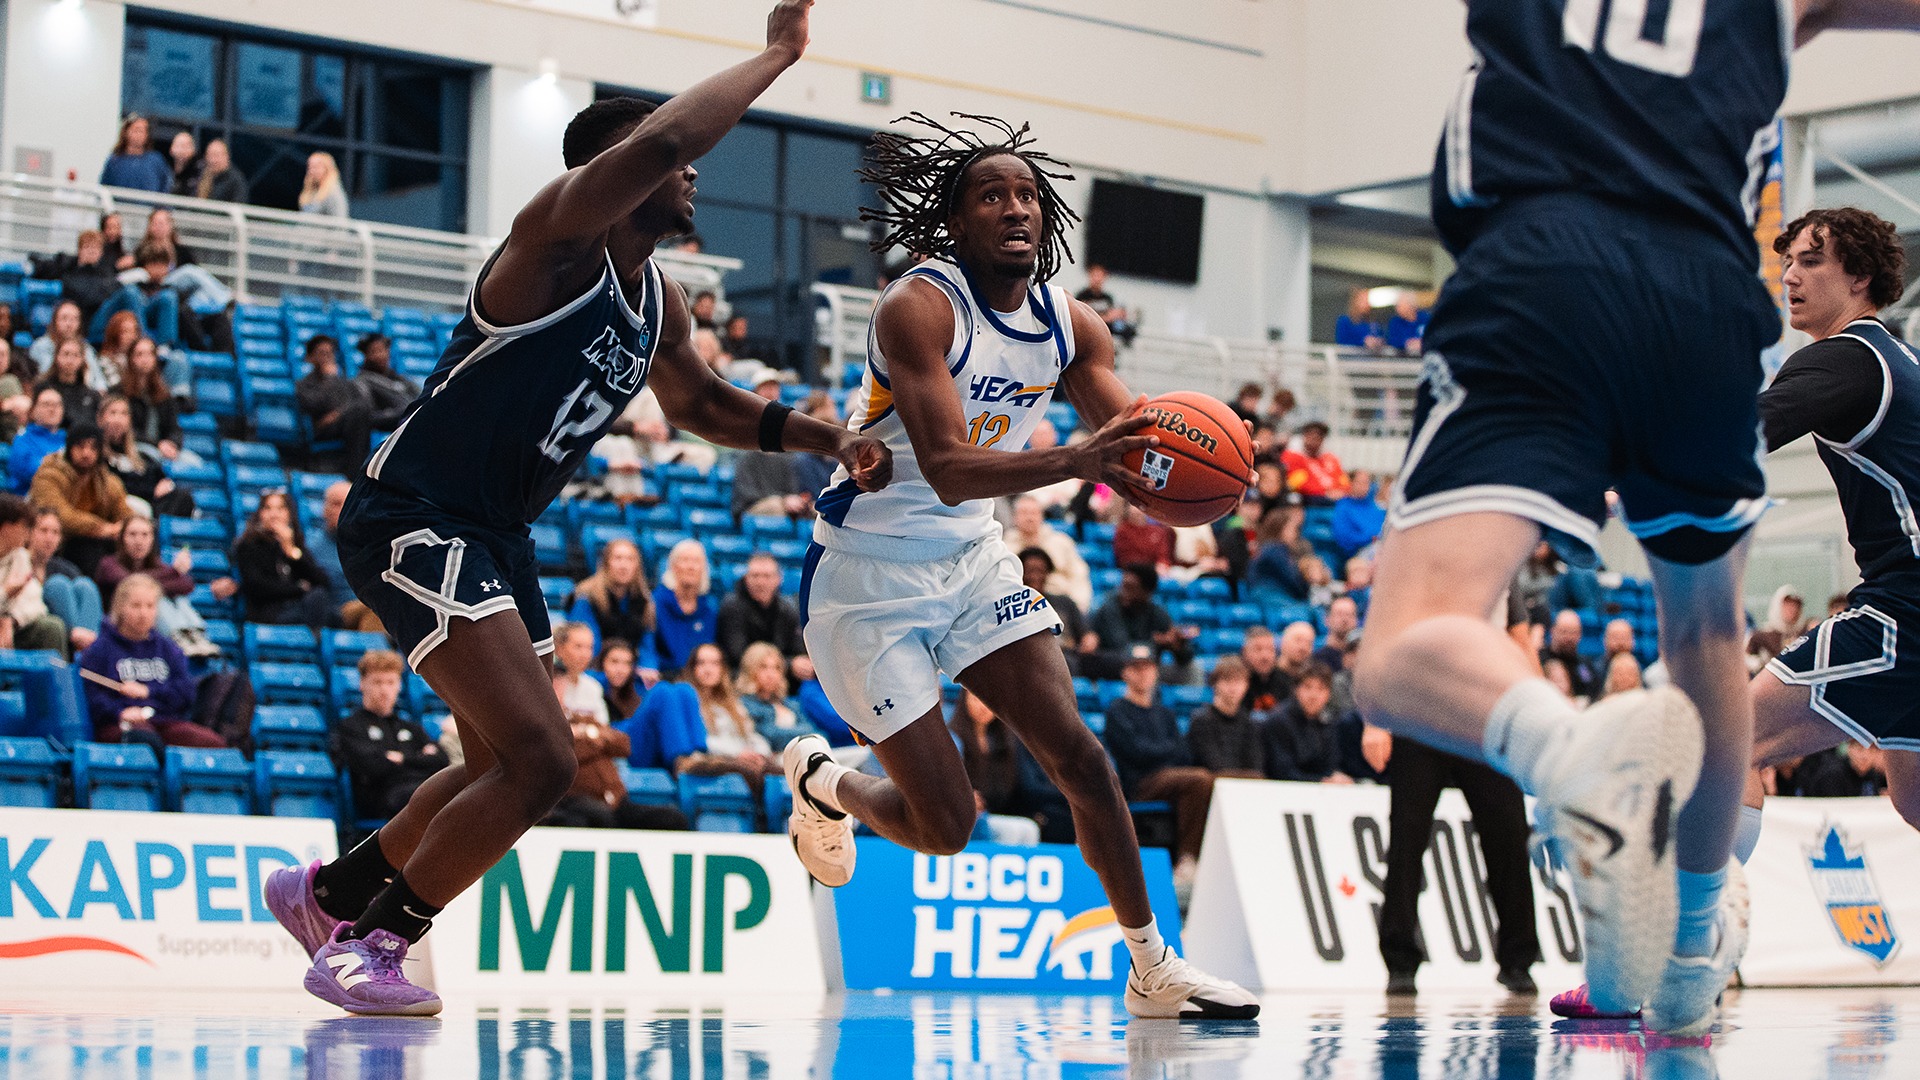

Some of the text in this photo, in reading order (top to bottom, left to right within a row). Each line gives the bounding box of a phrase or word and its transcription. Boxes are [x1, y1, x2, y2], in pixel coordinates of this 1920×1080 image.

[970, 375, 1056, 408] HEAT
[536, 377, 615, 466] 12
[968, 410, 1011, 450] 12
[1143, 463, 1168, 479] SPORTS
[994, 589, 1030, 611] UBCO
[996, 596, 1047, 626] HEAT
[912, 852, 1064, 903] UBCO
[477, 848, 772, 973] MNP
[1830, 904, 1892, 945] WEST
[157, 934, 273, 960] Supporting
[910, 906, 1125, 980] HEAT
